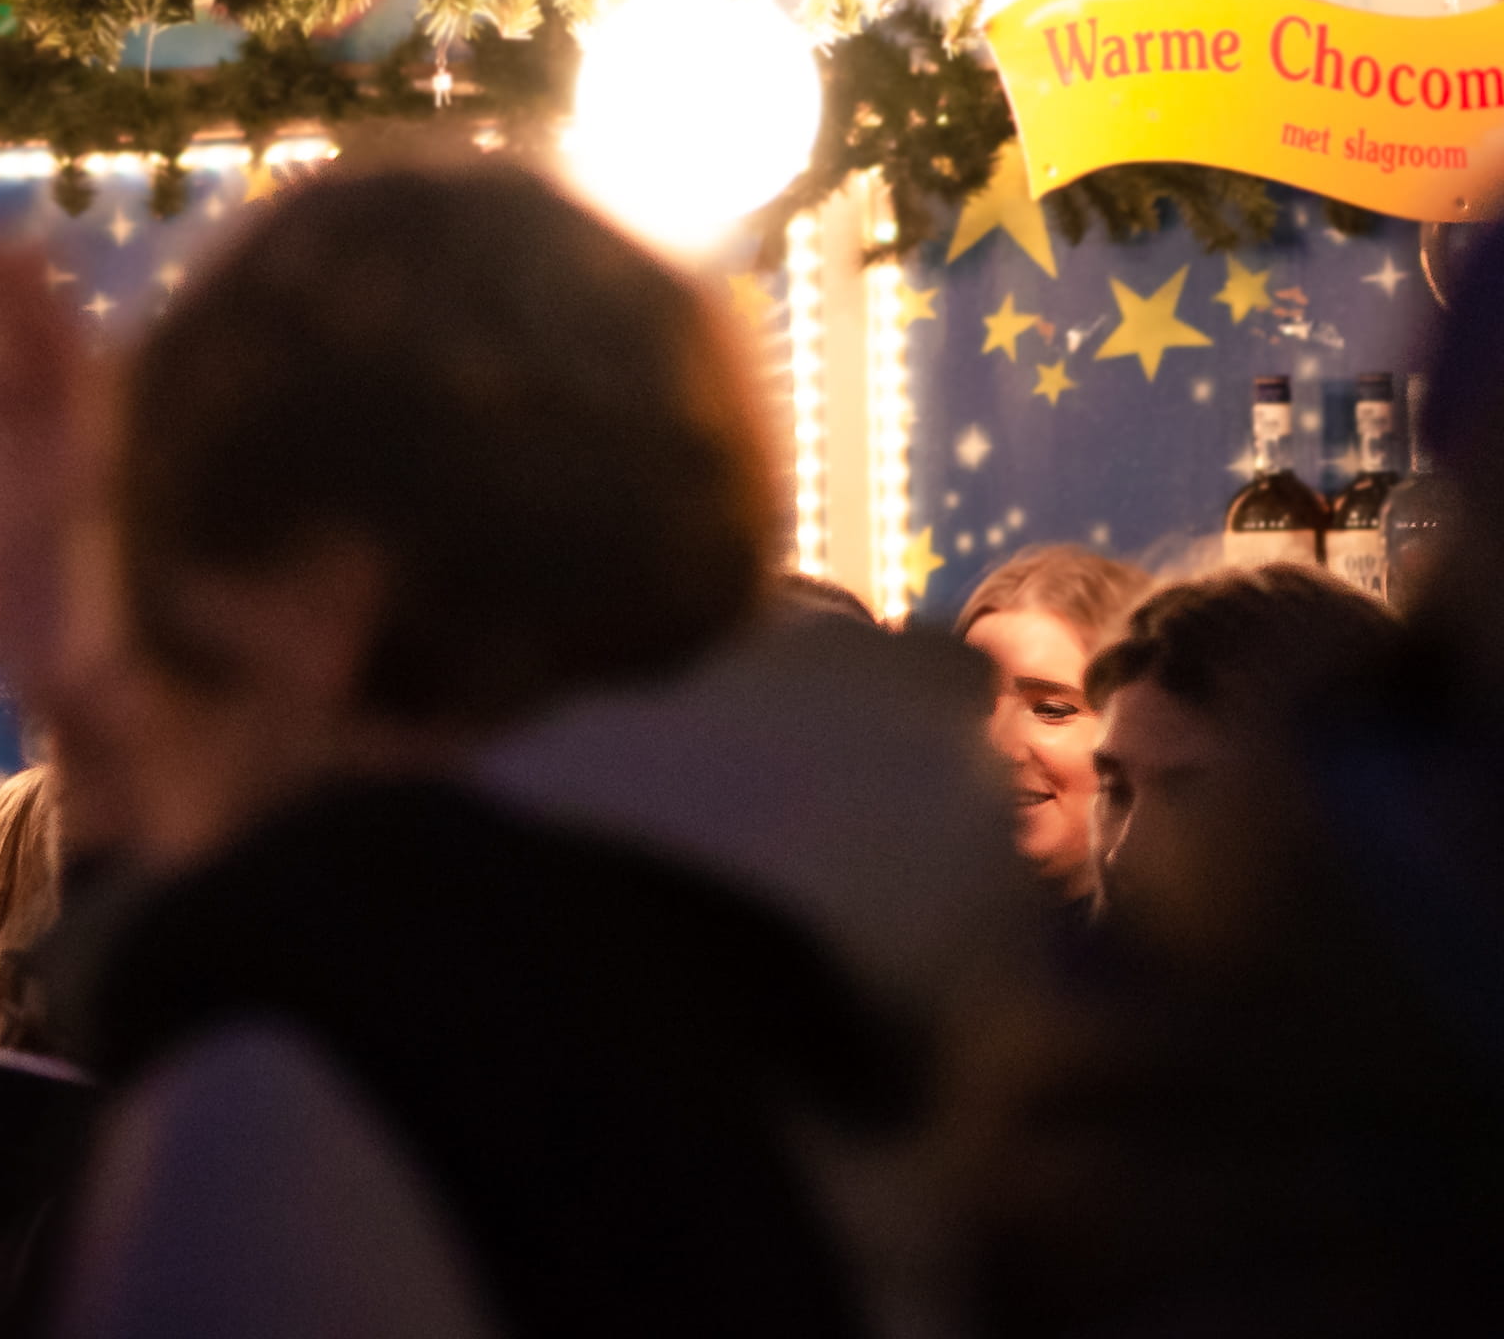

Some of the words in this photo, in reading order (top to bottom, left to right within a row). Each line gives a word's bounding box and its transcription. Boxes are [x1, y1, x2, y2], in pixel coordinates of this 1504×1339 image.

[1042, 17, 1242, 87] Warme
[1280, 123, 1331, 156] met
[1343, 129, 1469, 174] slagroom
